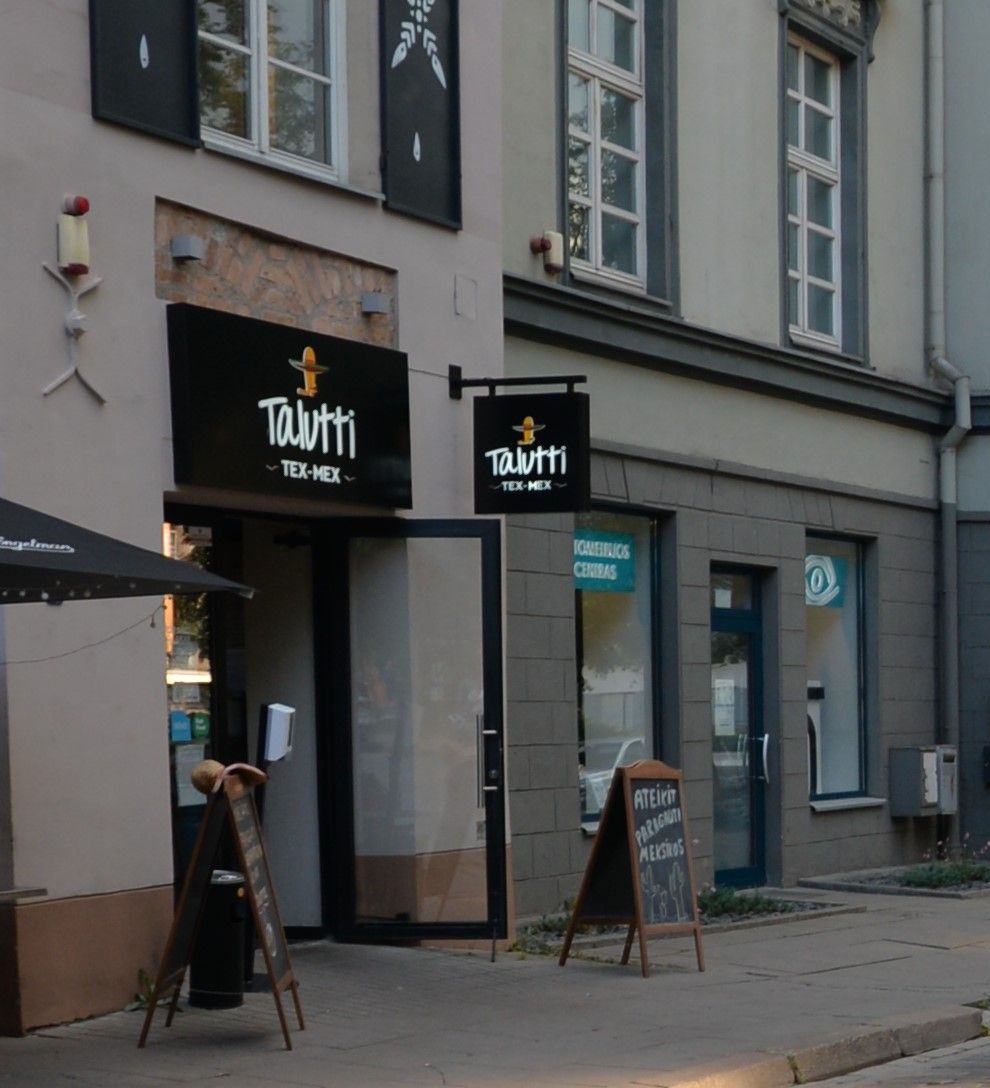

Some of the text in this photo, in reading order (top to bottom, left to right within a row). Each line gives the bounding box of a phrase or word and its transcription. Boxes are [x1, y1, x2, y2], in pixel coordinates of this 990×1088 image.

[258, 396, 355, 459] Talutti
[281, 459, 341, 484] TEX-MEX
[485, 445, 567, 476] Talutti
[501, 479, 552, 491] TEX-MEX
